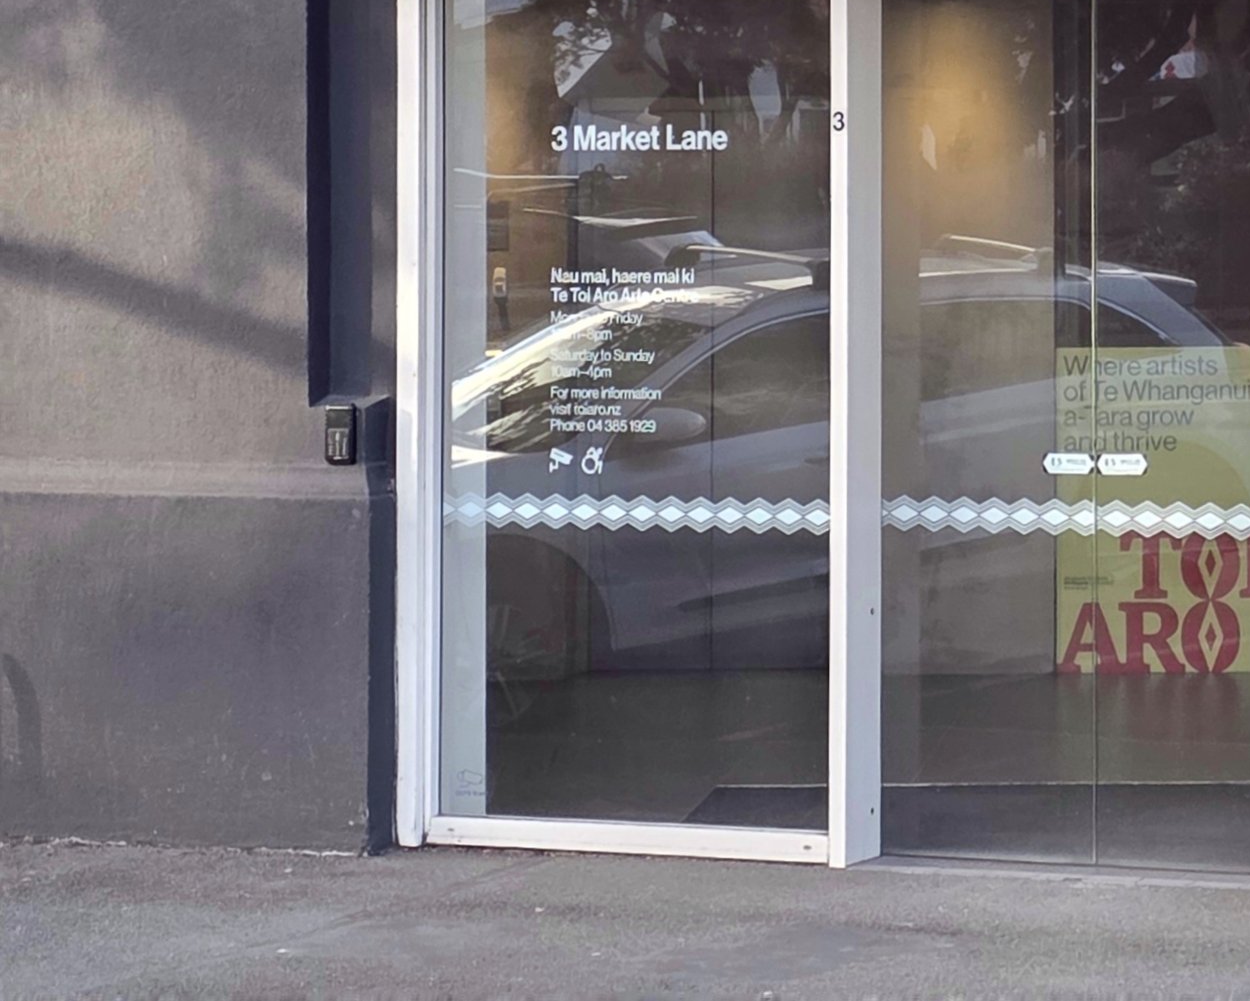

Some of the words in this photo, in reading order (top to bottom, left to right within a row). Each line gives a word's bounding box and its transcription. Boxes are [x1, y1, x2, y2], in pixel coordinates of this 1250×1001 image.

[833, 111, 845, 132] 3
[551, 126, 568, 151] 3
[573, 125, 660, 150] Market
[665, 124, 728, 150] Lane
[551, 268, 578, 284] Nau
[581, 268, 610, 286] mai,
[612, 268, 652, 284] haere
[654, 268, 679, 284] mai
[682, 268, 695, 284] ki
[551, 288, 568, 303] Te
[570, 288, 591, 303] Toi
[592, 288, 618, 303] Aro
[550, 349, 599, 364] Saturday
[601, 349, 611, 362] to
[613, 349, 655, 364] Sunday
[1146, 355, 1217, 376] artists
[550, 386, 568, 400] For
[570, 388, 599, 400] more
[601, 386, 661, 400] information
[1064, 380, 1086, 402] of
[550, 404, 571, 416] visit
[550, 420, 585, 432] Phone
[587, 420, 602, 432] 04
[604, 421, 627, 433] 385
[629, 421, 656, 433] 1929
[1136, 411, 1194, 432] grow
[1113, 432, 1177, 452] thrive
[1057, 600, 1241, 673] ARO
